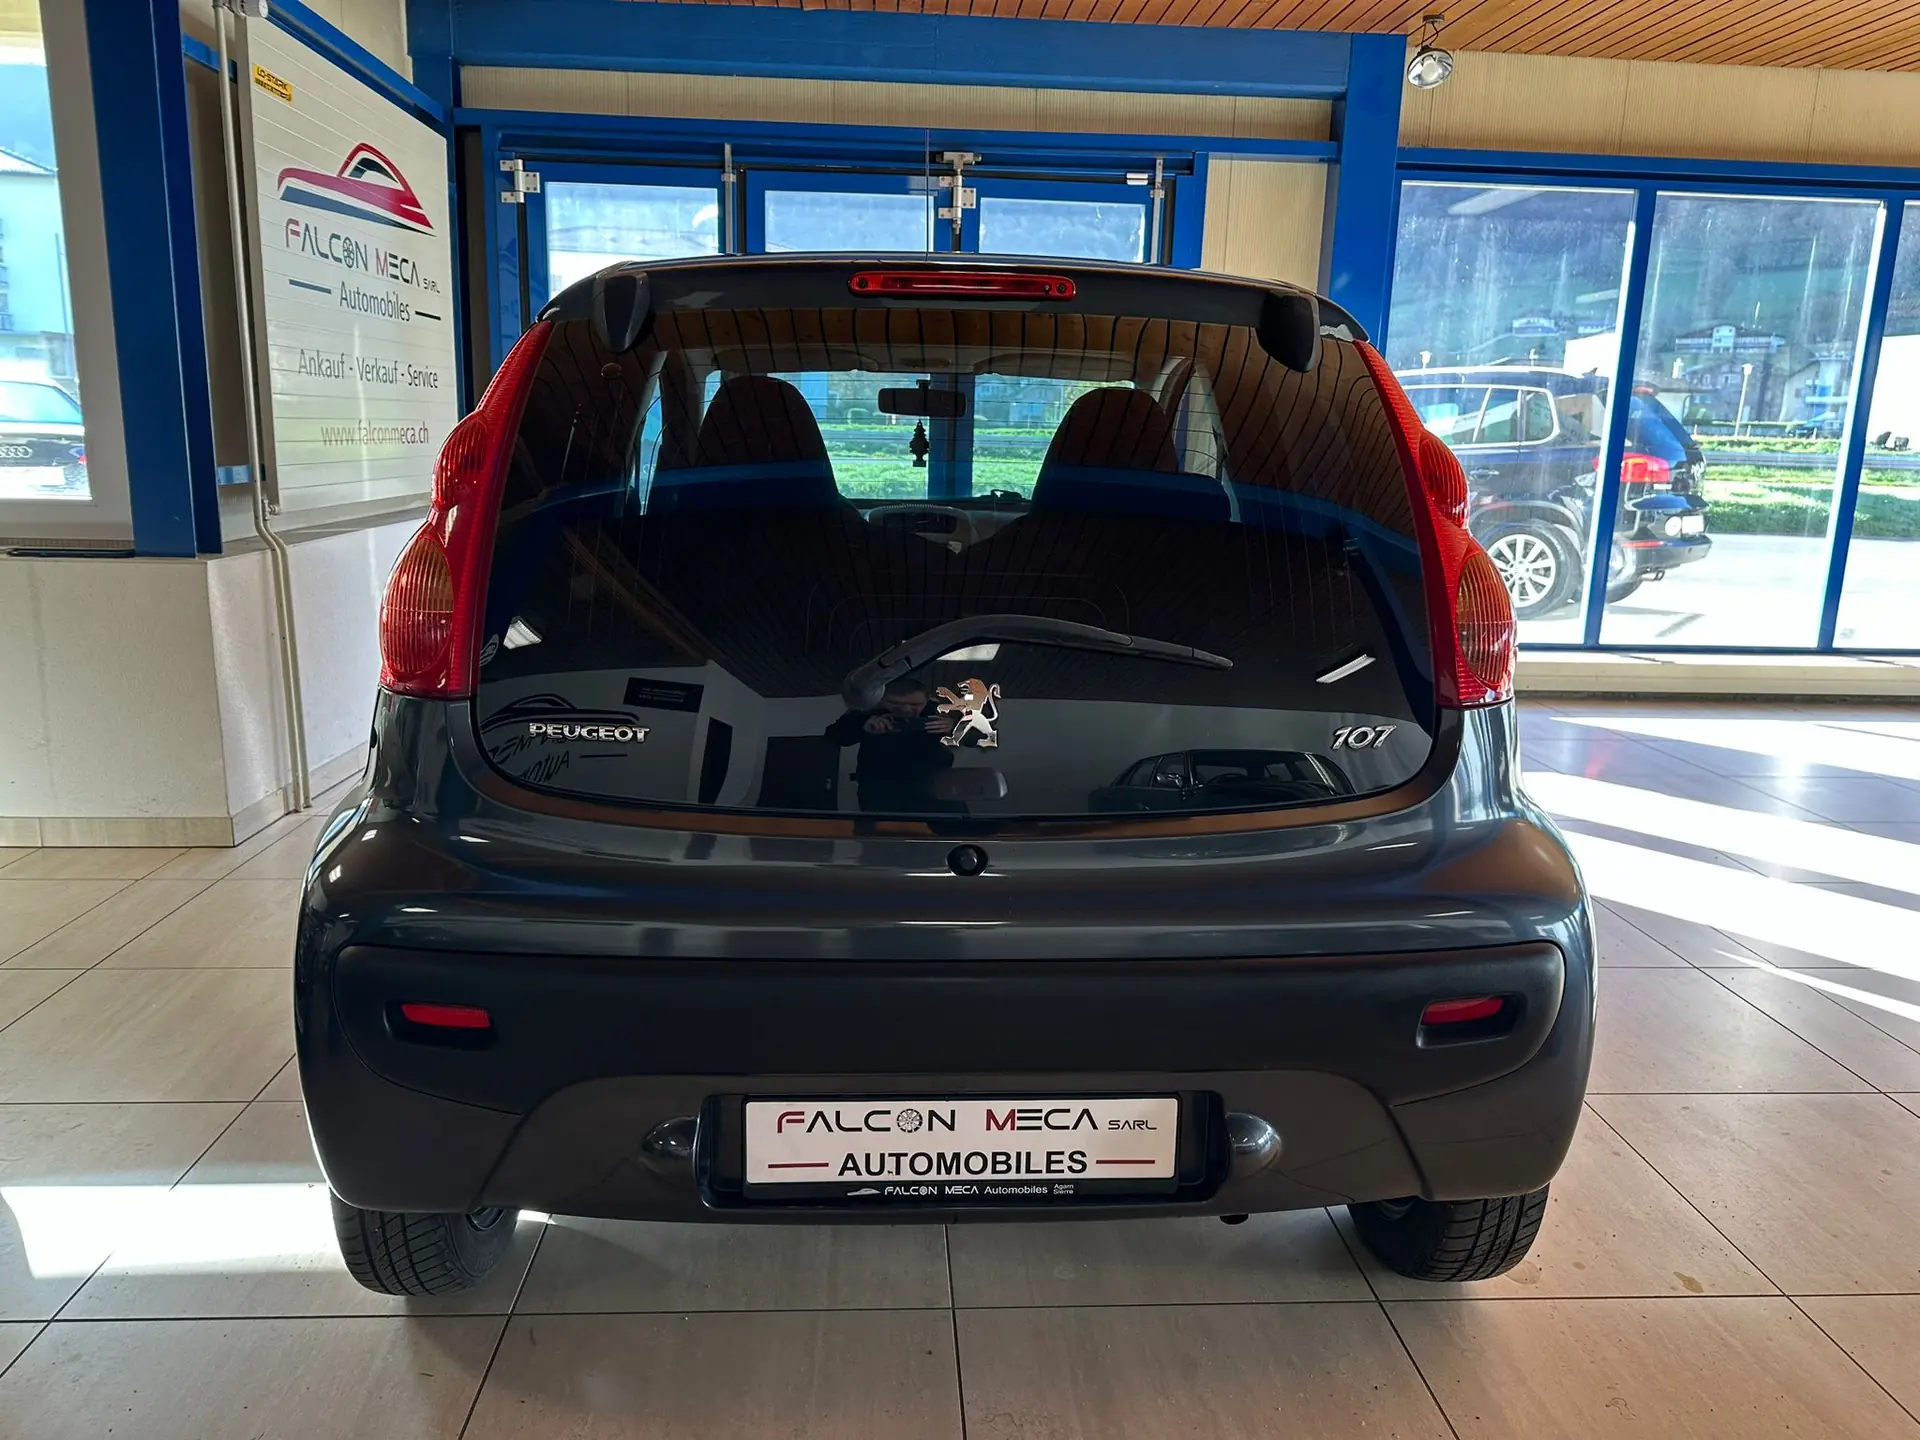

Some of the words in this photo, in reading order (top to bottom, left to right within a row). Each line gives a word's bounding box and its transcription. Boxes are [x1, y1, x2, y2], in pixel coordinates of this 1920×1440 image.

[285, 218, 368, 271] FALCON
[375, 247, 420, 287] MECA
[422, 277, 441, 294] SARL
[339, 281, 411, 322] Automobiles
[298, 349, 345, 380] Ankauf
[356, 356, 398, 385] Verkauf
[407, 364, 439, 389] Service
[321, 420, 429, 446] www.falconmeca.ch
[529, 722, 650, 743] PEUGEOT
[1331, 724, 1397, 750] 107
[776, 1108, 956, 1133] FALCON
[985, 1108, 1099, 1131] MECA
[1107, 1119, 1158, 1131] SARL
[837, 1150, 1088, 1177] AUTOMOBILES
[884, 1185, 938, 1196] FALCON
[944, 1185, 979, 1195] MECA
[984, 1184, 1048, 1195] Automobiles
